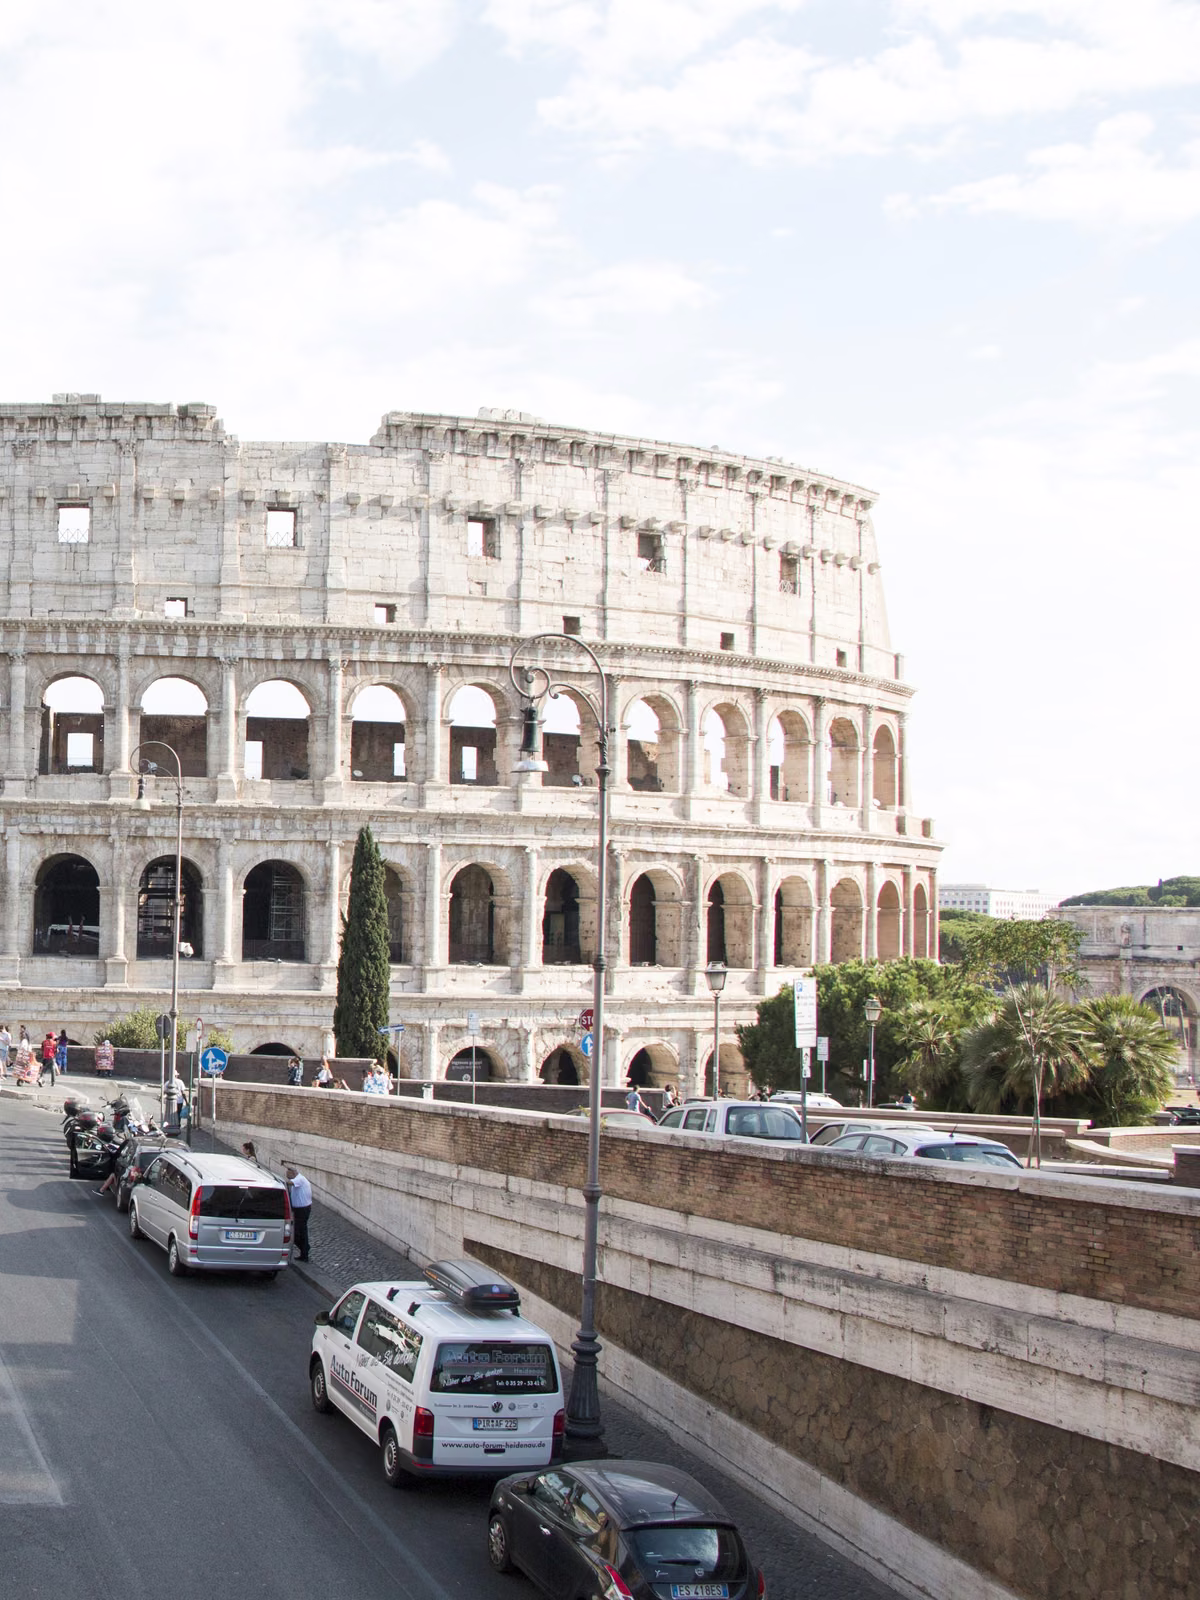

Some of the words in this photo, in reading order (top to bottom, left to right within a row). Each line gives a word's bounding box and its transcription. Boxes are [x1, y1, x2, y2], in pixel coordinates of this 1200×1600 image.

[447, 1349, 490, 1364] Auto
[491, 1349, 546, 1365] Forum
[330, 1354, 350, 1385] Auto
[350, 1370, 378, 1408] Forum
[504, 1419, 517, 1428] 225
[441, 1441, 546, 1449] www.auto-forum-heidenau.de
[678, 1585, 691, 1596] ES
[693, 1585, 722, 1596] 418ES
